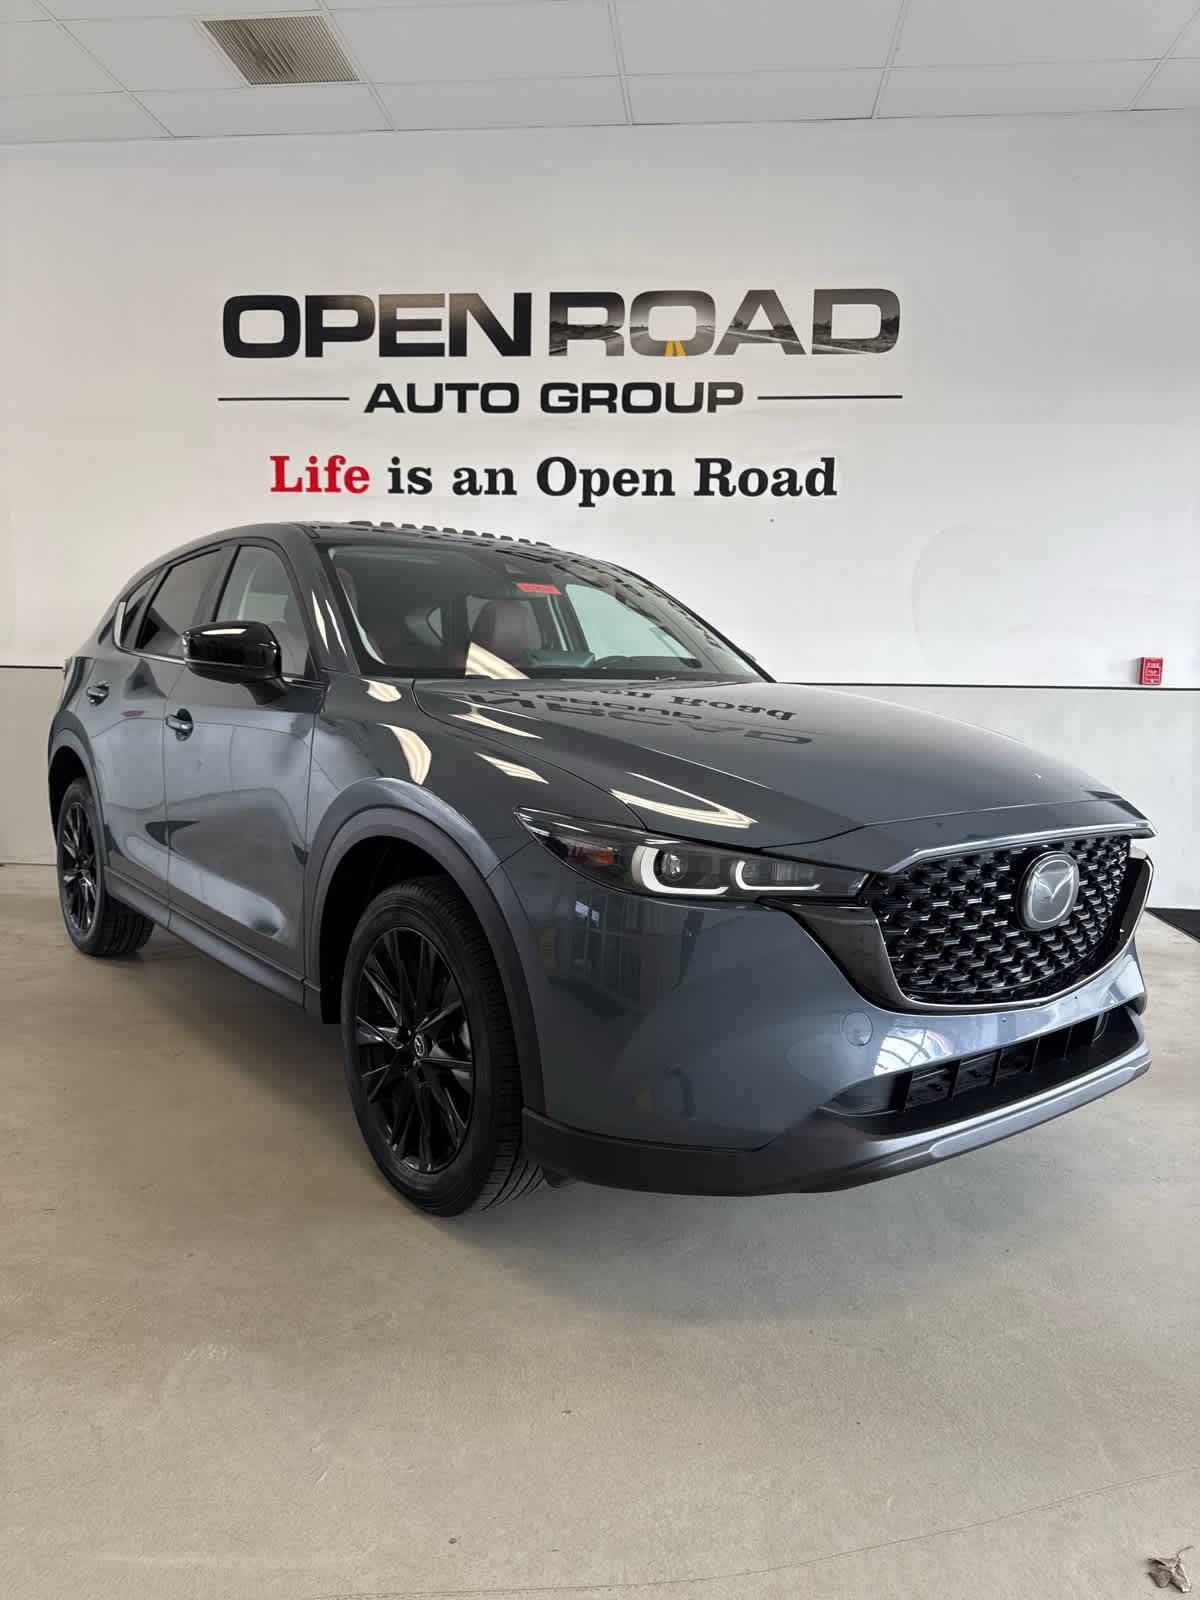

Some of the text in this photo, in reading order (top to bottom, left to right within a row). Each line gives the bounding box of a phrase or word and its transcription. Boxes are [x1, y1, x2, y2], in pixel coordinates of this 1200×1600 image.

[223, 288, 901, 359] OPEN ROAD
[364, 382, 744, 414] AUTO GROUP
[269, 455, 838, 508] Life is an Open Road
